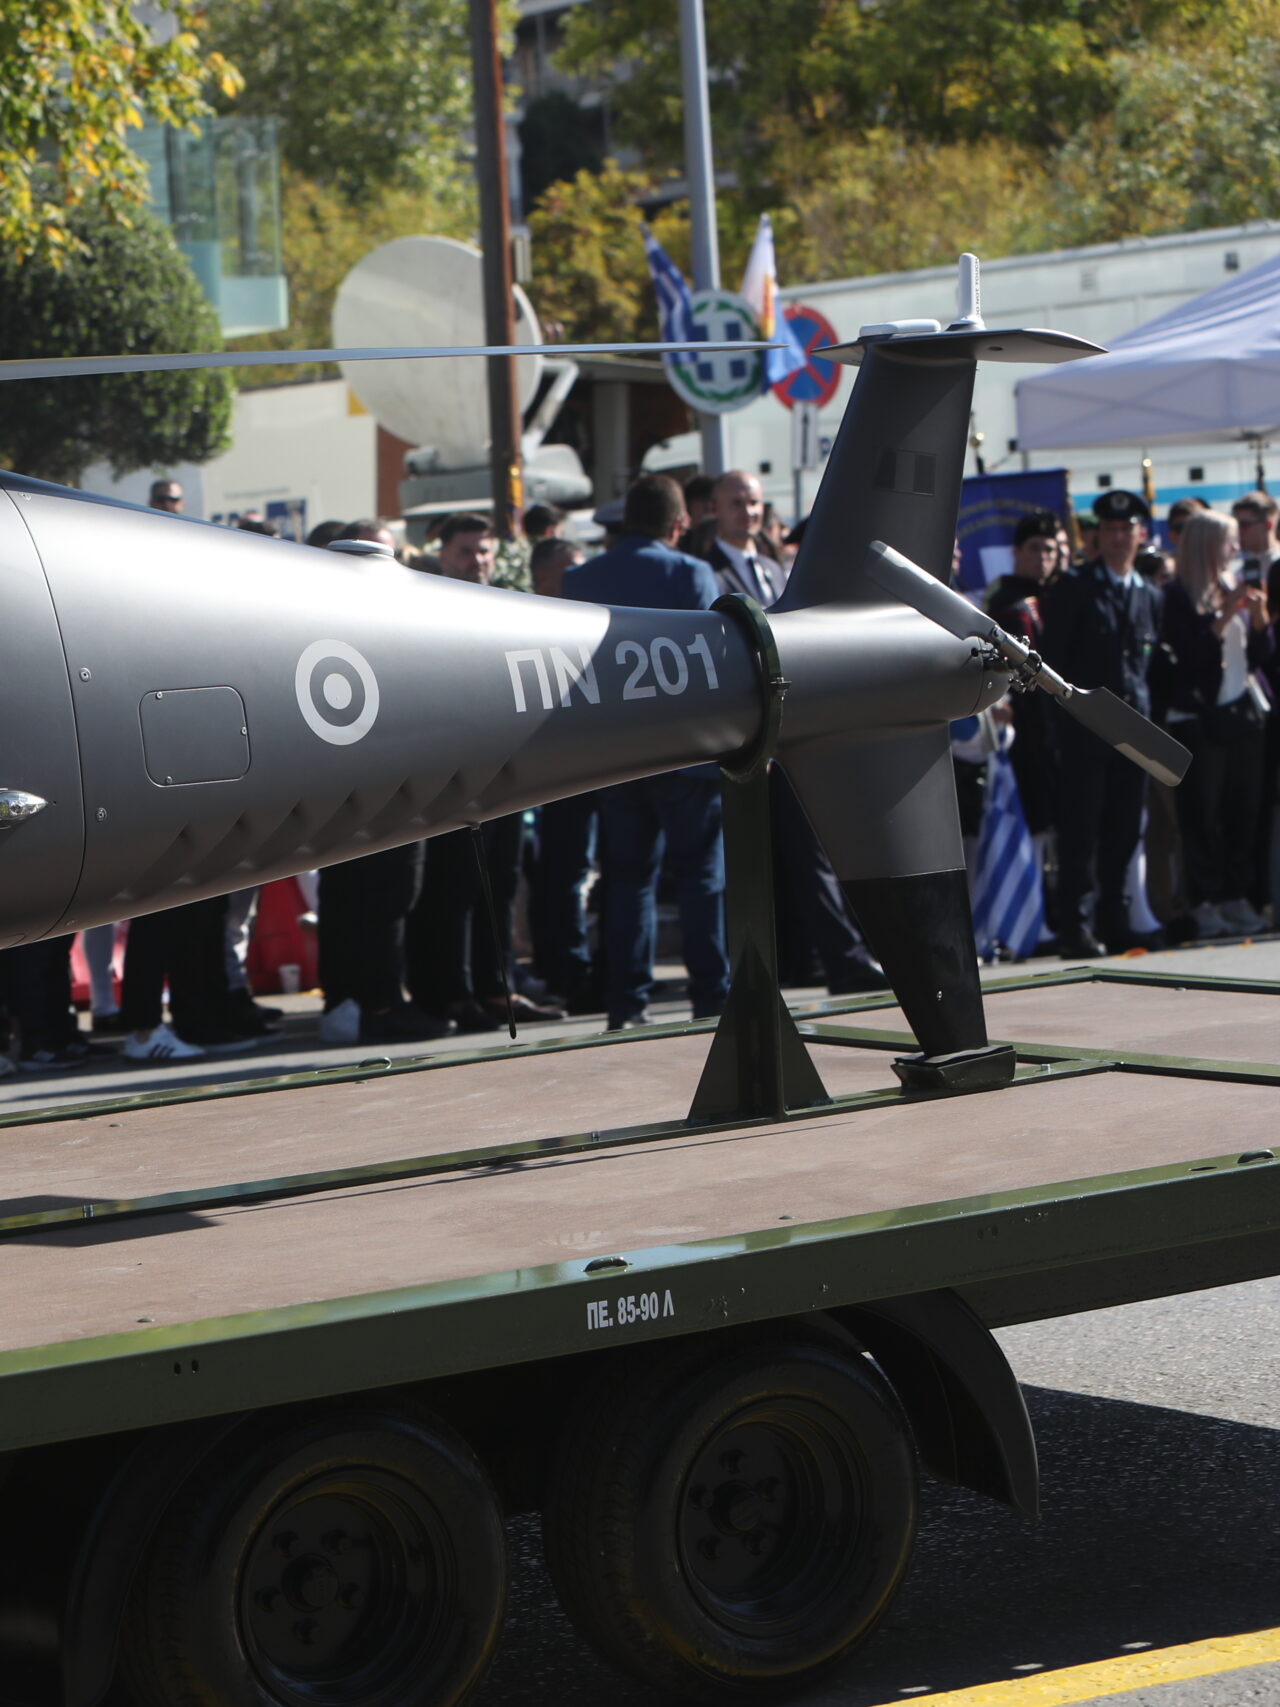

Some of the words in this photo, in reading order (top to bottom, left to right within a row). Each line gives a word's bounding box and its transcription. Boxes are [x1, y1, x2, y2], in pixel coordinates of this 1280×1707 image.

[504, 644, 602, 713] ΠΝ
[615, 633, 719, 700] 201
[587, 1300, 614, 1330] ΠΕ.
[617, 1291, 659, 1325] 85-90
[663, 1289, 675, 1317] Λ
